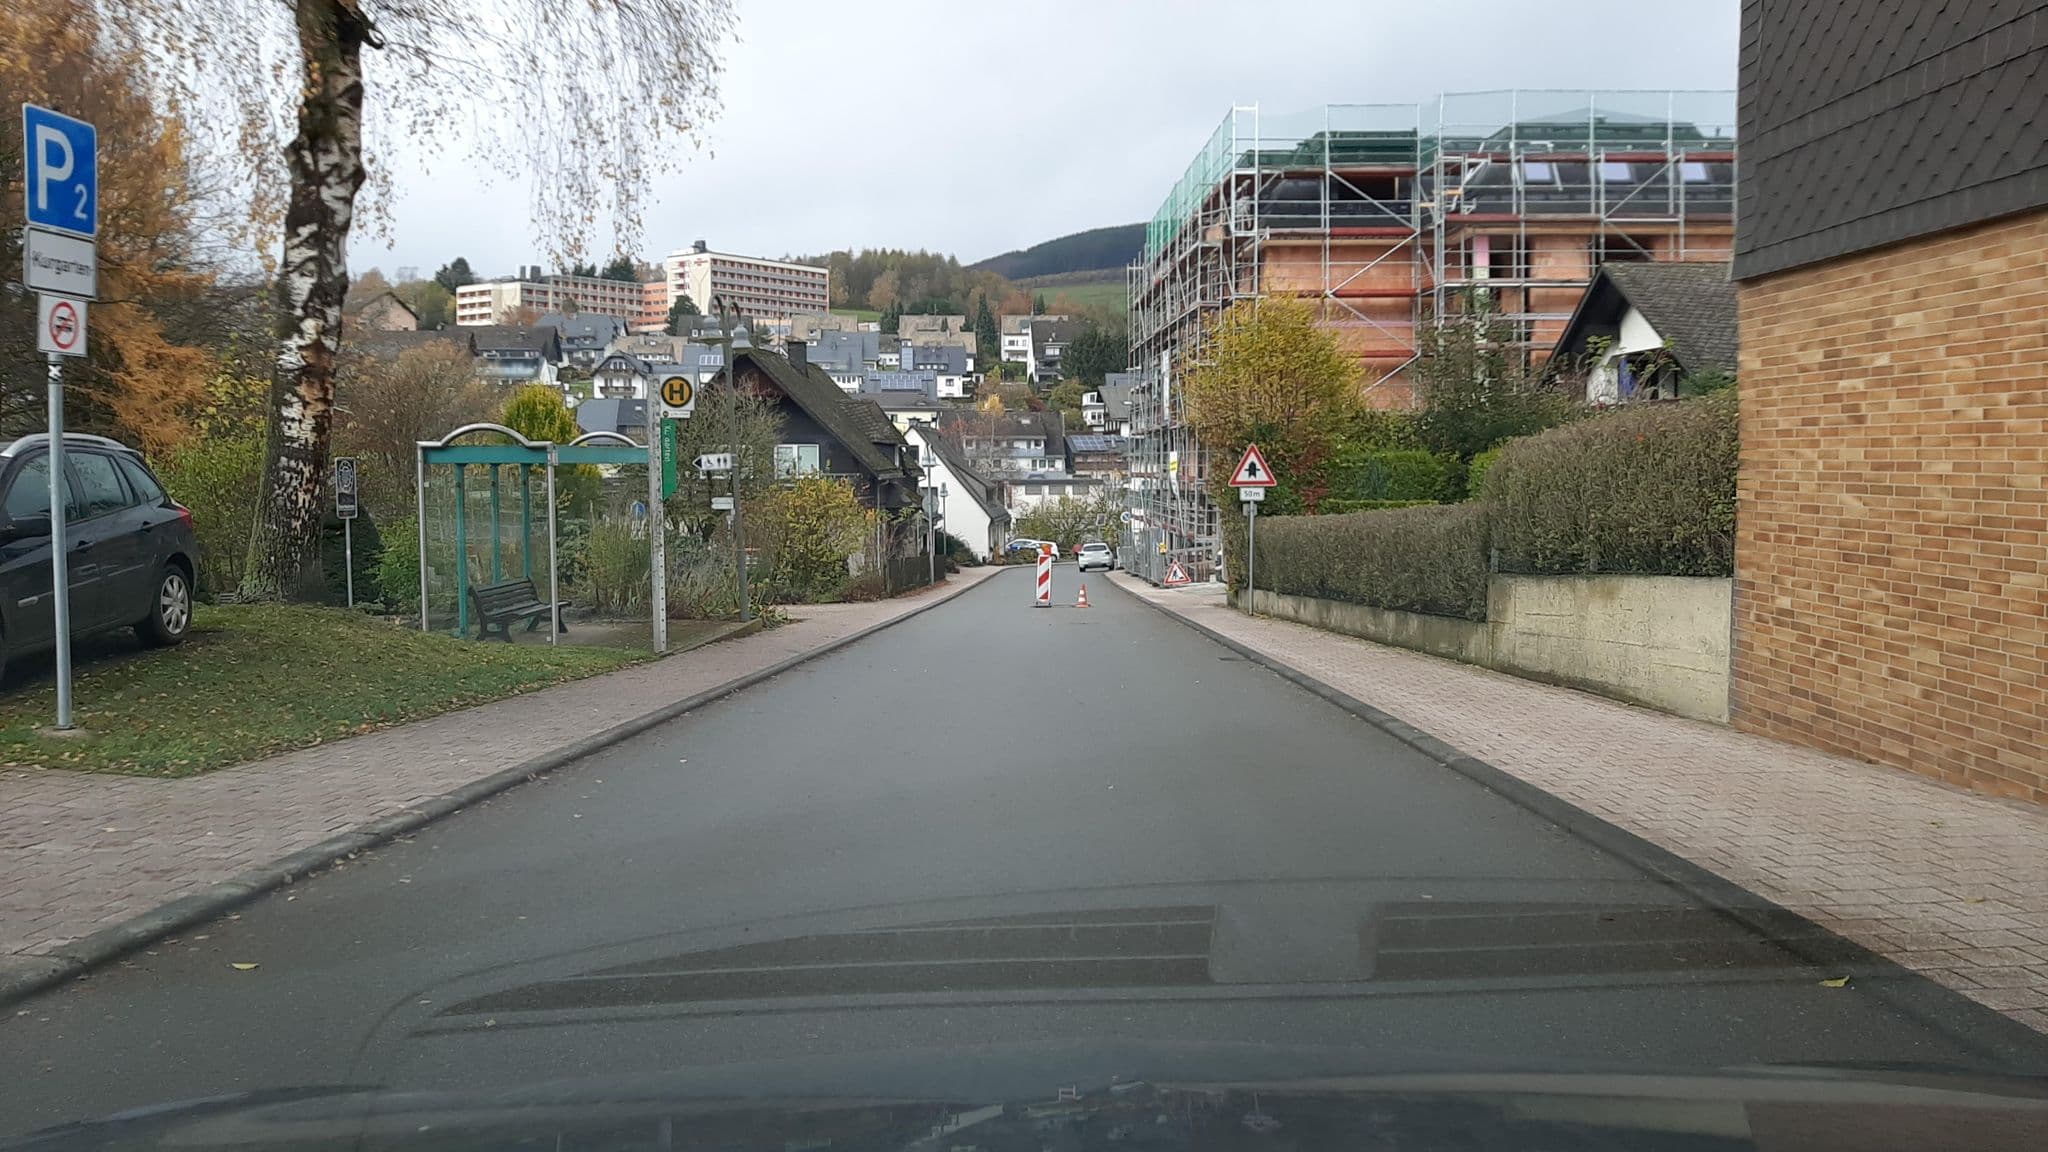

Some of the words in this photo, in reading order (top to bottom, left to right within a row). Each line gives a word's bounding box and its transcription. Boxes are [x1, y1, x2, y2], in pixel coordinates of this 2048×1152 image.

[36, 123, 74, 210] P
[74, 183, 88, 220] 2
[31, 250, 91, 277] Kurgarten
[668, 383, 684, 401] H
